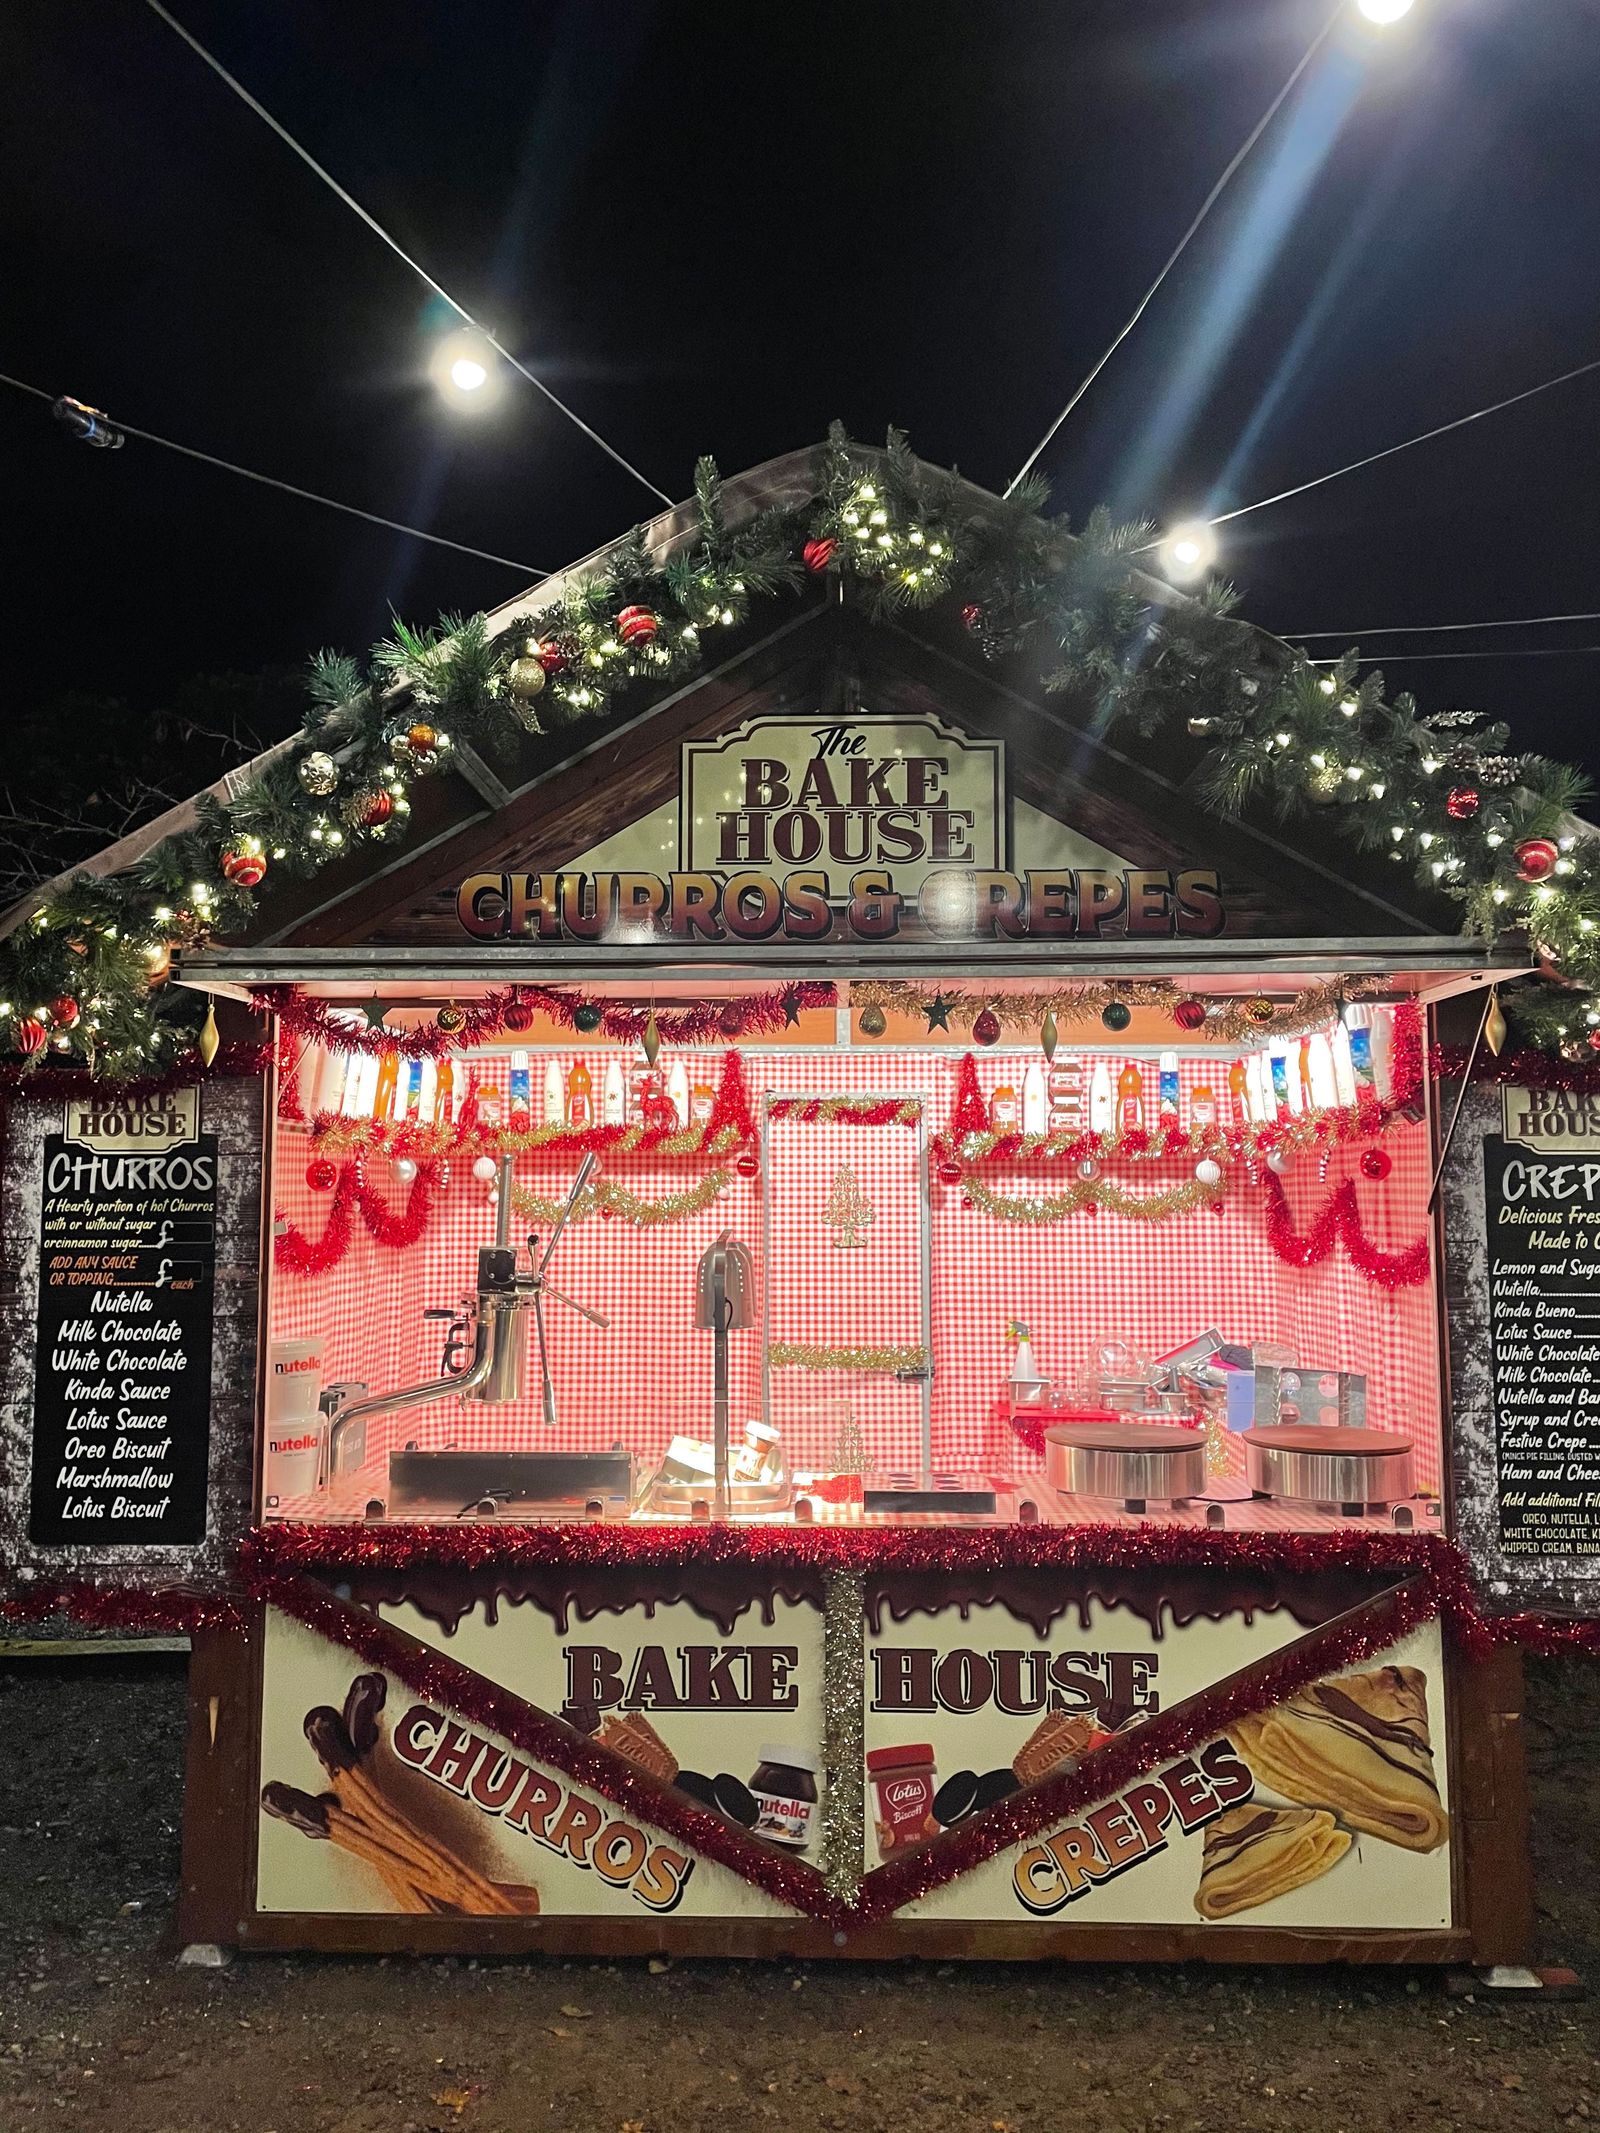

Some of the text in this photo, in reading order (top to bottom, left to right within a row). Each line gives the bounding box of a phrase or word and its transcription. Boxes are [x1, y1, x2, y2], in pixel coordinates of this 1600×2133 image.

[811, 725, 867, 759] The
[741, 758, 949, 811] BAKE
[715, 810, 975, 865] HOUSE
[456, 870, 834, 942] CHURROS
[847, 869, 905, 940] &
[78, 1113, 186, 1137] HOUSE
[48, 1153, 213, 1194] CHURROS
[44, 1198, 214, 1216] A Hearty portion of hot Churros
[1498, 1205, 1563, 1225] Delicious
[44, 1217, 66, 1230] with
[69, 1221, 82, 1230] or
[85, 1216, 125, 1230] without
[125, 1220, 156, 1234] sugar
[1528, 1230, 1570, 1250] Made
[1575, 1231, 1588, 1249] to
[49, 1255, 138, 1269] ADD ANY SAUCE
[1492, 1258, 1536, 1275] Lemon
[1539, 1258, 1567, 1275] and
[49, 1272, 66, 1285] OR
[170, 1278, 194, 1290] each
[1493, 1280, 1541, 1297] Nutella
[90, 1291, 153, 1313] Nutella
[1494, 1301, 1576, 1318] Kinda Bueno
[57, 1320, 182, 1342] Milk Chocolate
[1496, 1323, 1572, 1340] Lotus Sauce
[51, 1349, 187, 1371] White Chocolate
[1496, 1344, 1600, 1362] White Chocolate
[275, 1356, 321, 1375] nutella
[1497, 1366, 1592, 1383] Milk Chocolate
[64, 1378, 171, 1400] Kinda Sauce
[1498, 1387, 1545, 1405] Nutella
[1548, 1387, 1576, 1404] and
[66, 1408, 168, 1430] Lotus Sauce
[1500, 1409, 1540, 1431] Syrup
[1543, 1410, 1571, 1427] and
[64, 1437, 172, 1460] Oreo Biscuit
[270, 1434, 318, 1453] nutella
[1500, 1431, 1587, 1453] Festive Crepe
[1526, 1452, 1538, 1460] PIE
[56, 1466, 174, 1489] Marshmallow
[1501, 1463, 1600, 1481] Ham and Chee
[62, 1496, 171, 1519] Lotus Biscuit
[1501, 1491, 1527, 1508] Add
[1585, 1492, 1600, 1508] Fil
[1503, 1527, 1532, 1539] WHITE
[1500, 1542, 1539, 1553] WHIPPED
[563, 1646, 1160, 1715] BAKE HOUSE
[892, 1784, 922, 1801] Lotus
[391, 1703, 696, 1913] CHURROS
[1012, 1737, 1255, 1916] CREPES
